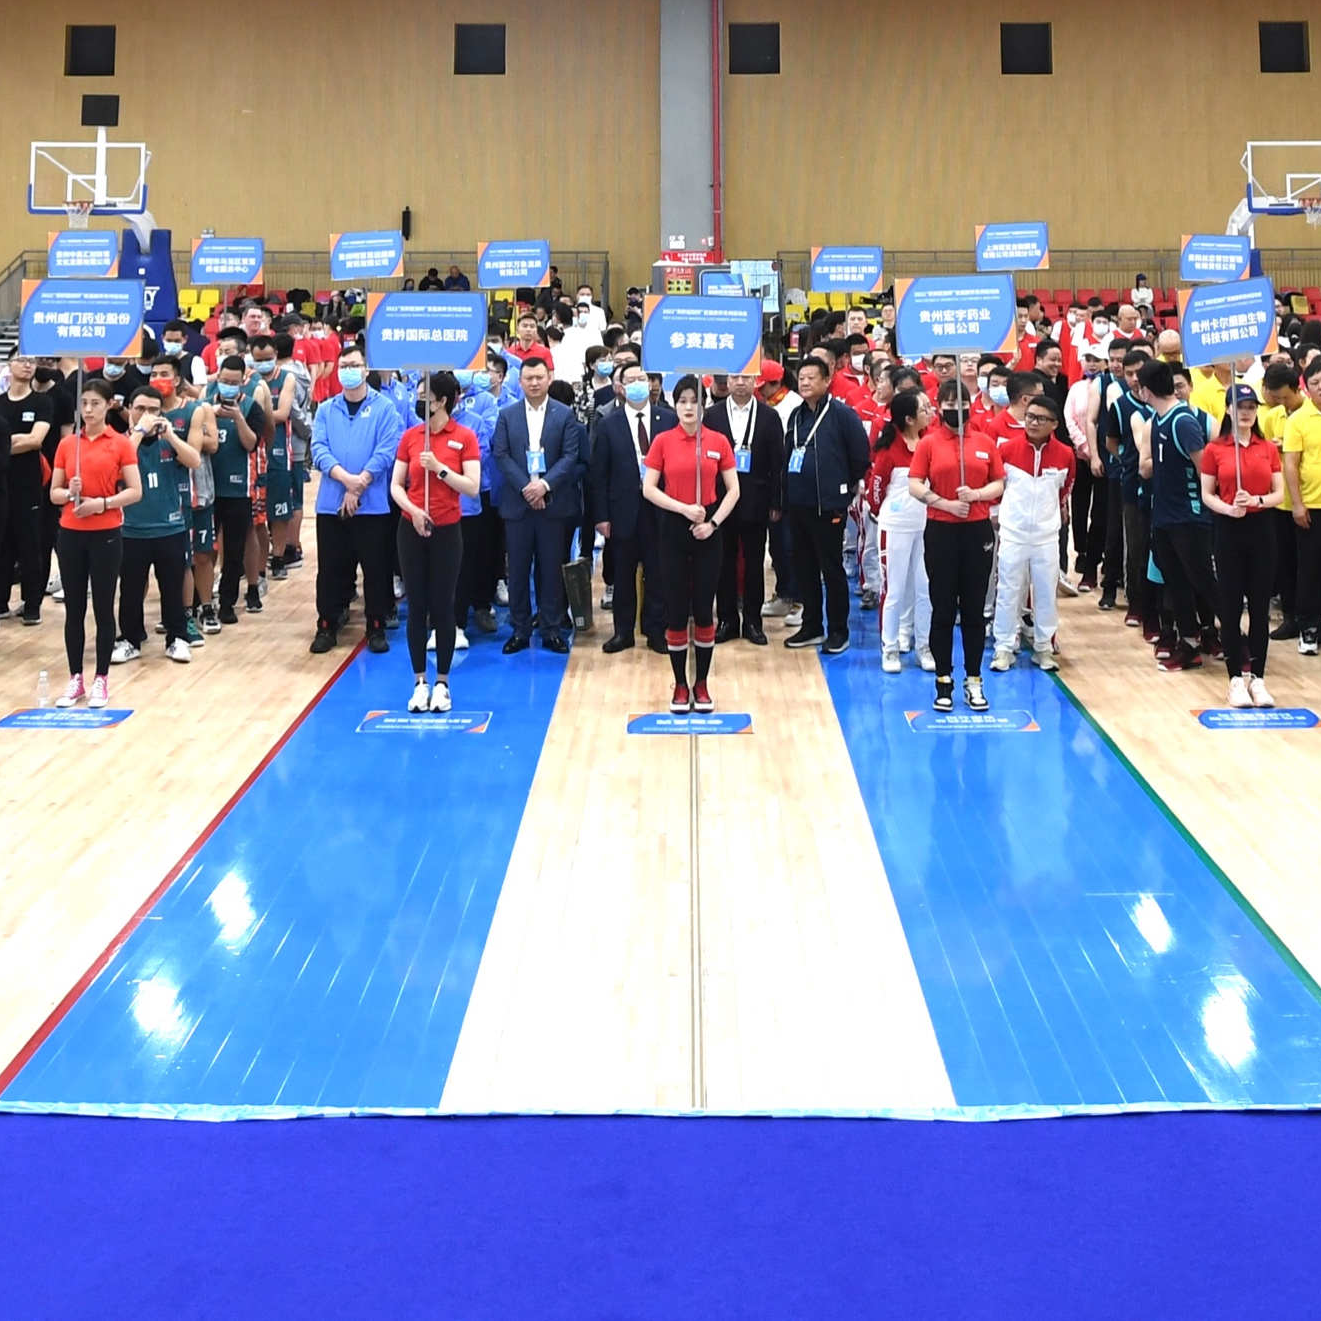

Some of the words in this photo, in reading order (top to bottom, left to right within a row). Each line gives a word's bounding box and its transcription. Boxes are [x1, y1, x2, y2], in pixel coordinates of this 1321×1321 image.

[32, 311, 131, 326] 贵州威门药业股份
[918, 308, 992, 324] 贵州宏宇药业
[1190, 310, 1268, 336] 贵州卡尔细胞生物
[56, 325, 106, 339] 有限公司
[380, 327, 469, 343] 贵黔国际总医院
[931, 321, 981, 337] 有限公司
[1200, 325, 1260, 346] 科技有限公司
[669, 331, 735, 351] 参赛嘉宾
[147, 472, 159, 489] 11
[274, 501, 289, 517] 20
[198, 529, 208, 544] 7
